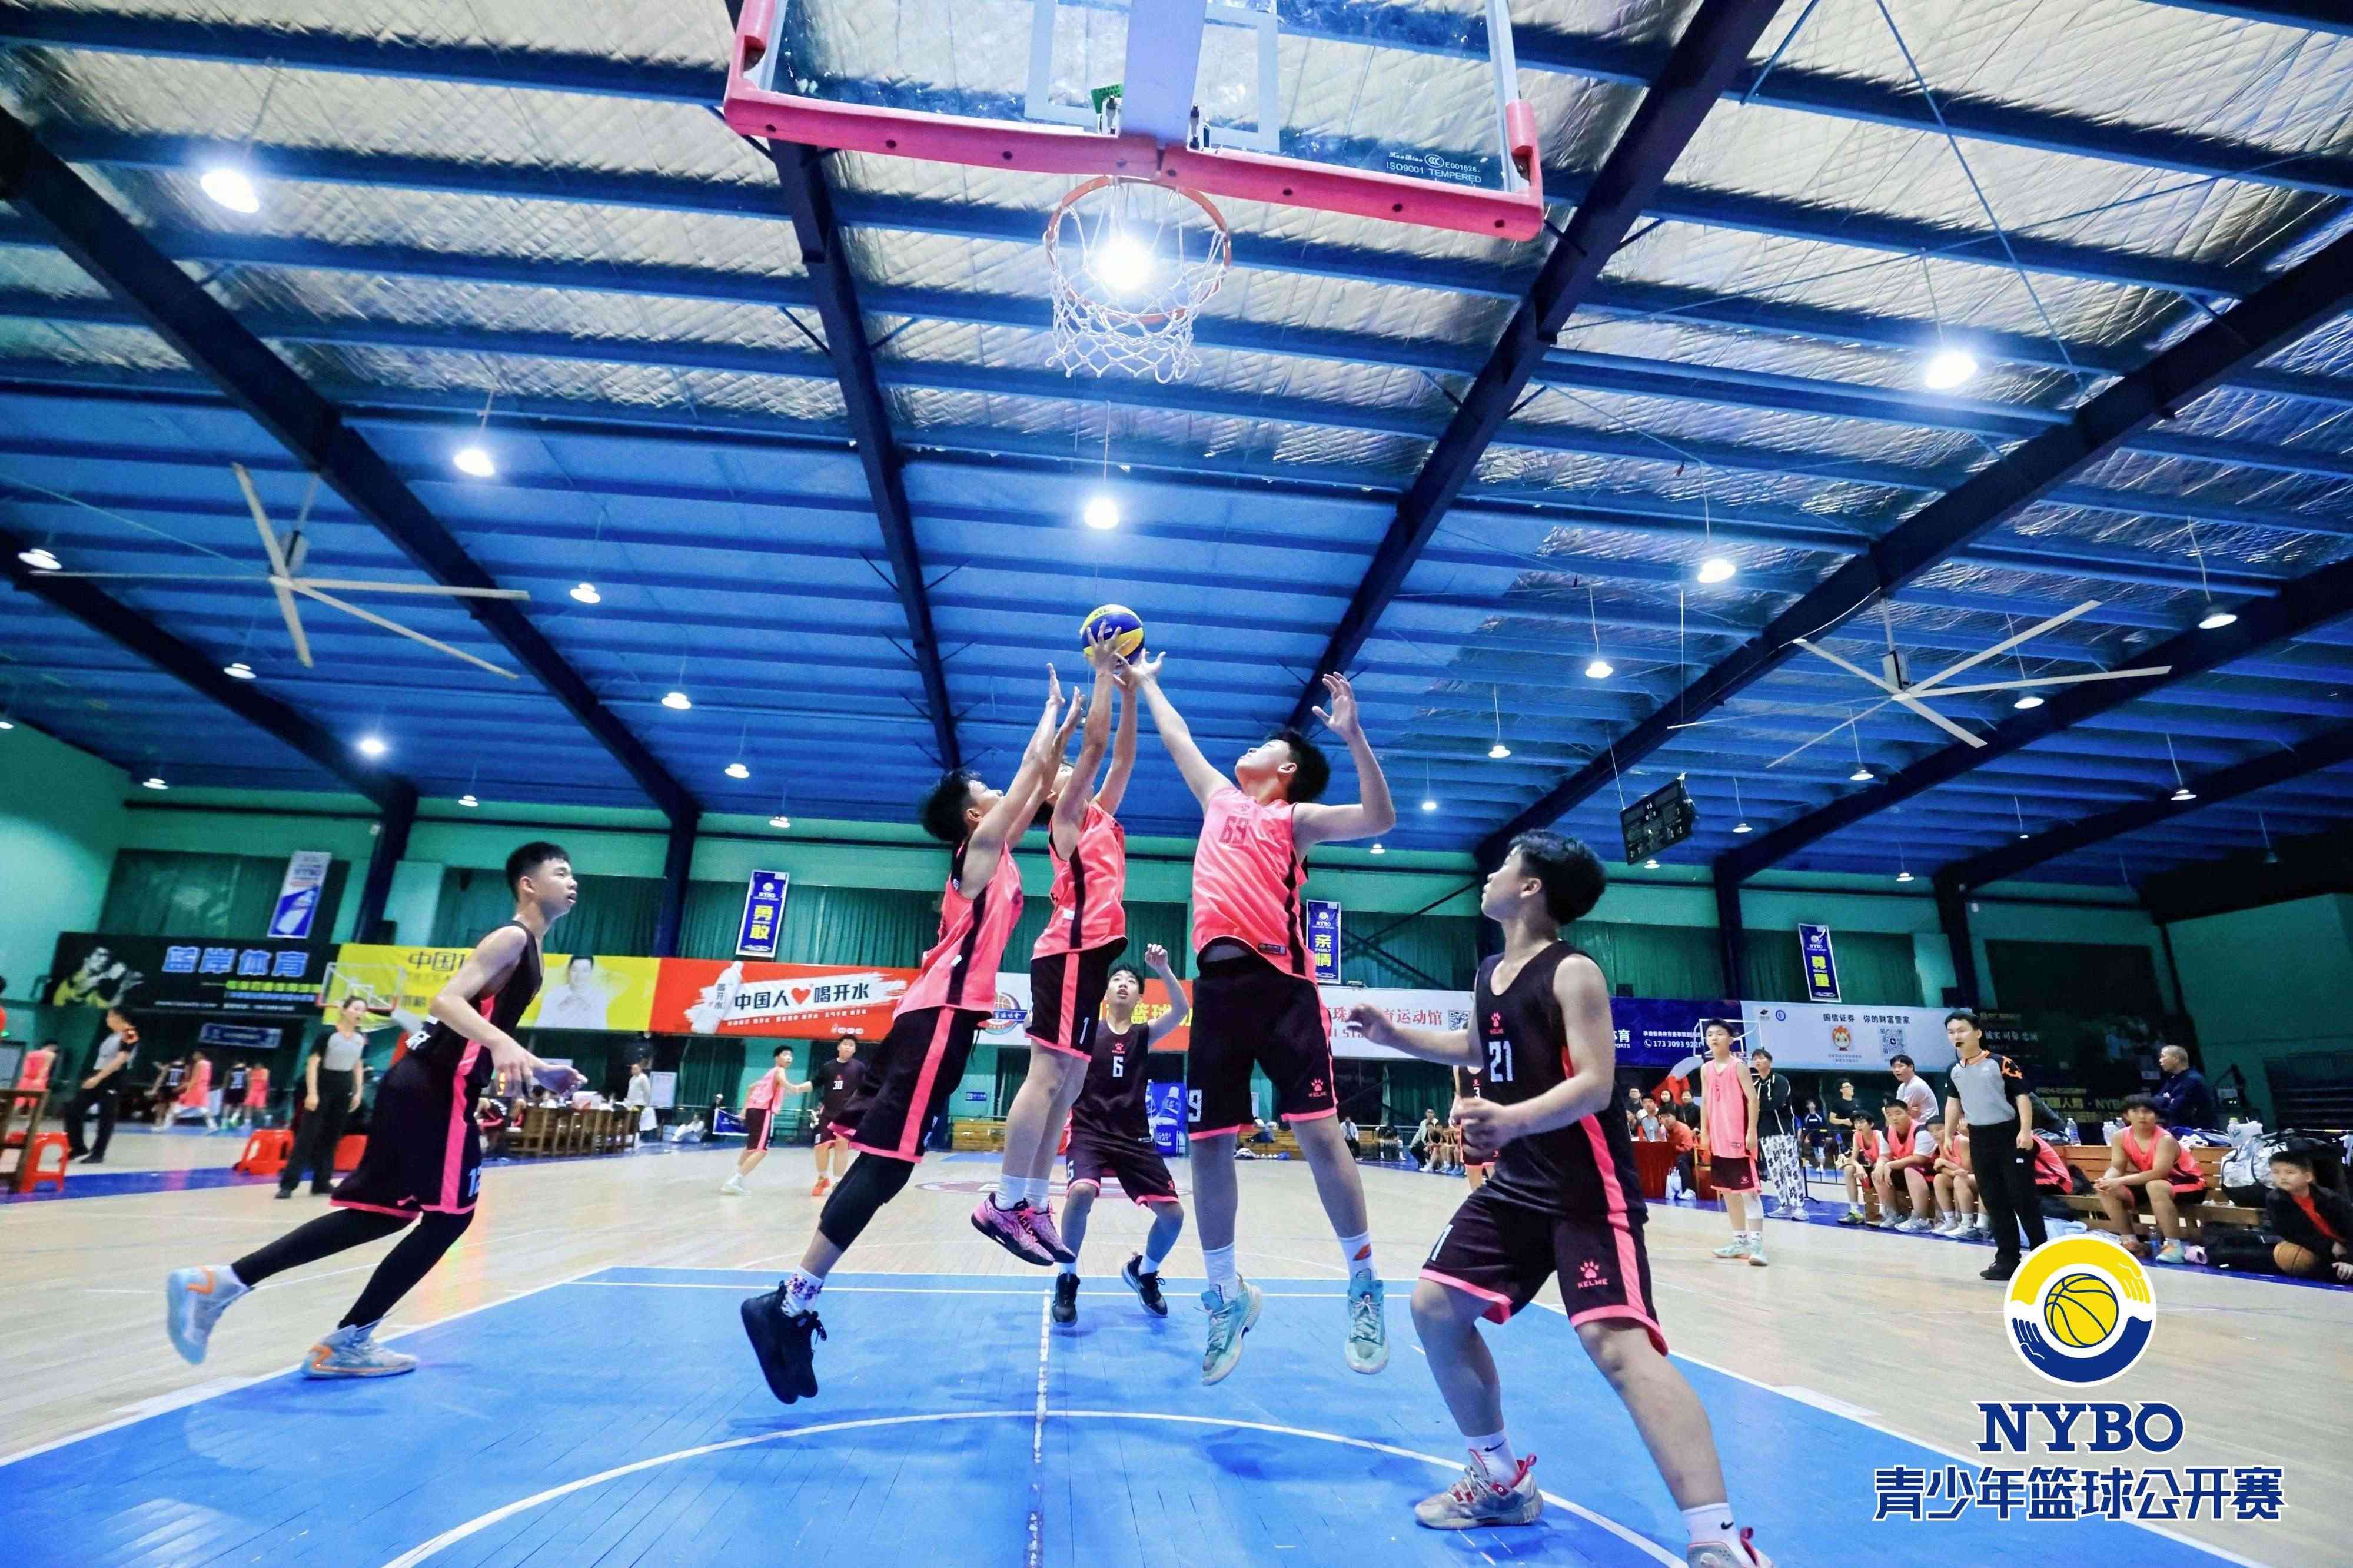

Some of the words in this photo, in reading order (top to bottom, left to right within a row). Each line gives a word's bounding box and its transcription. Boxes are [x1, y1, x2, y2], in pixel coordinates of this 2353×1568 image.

[1386, 161, 1424, 174] ISO9001
[1428, 168, 1482, 183] TEMPERED
[408, 951, 465, 971] 中国
[735, 989, 789, 1011] 中国人
[813, 982, 869, 1003] 喝开水
[1823, 1013, 1855, 1023] 国信证券
[1863, 1015, 1911, 1024] 你的财富管家
[1112, 1055, 1124, 1077] 6
[1488, 1040, 1513, 1082] 21
[1577, 1278, 1608, 1290] KELME
